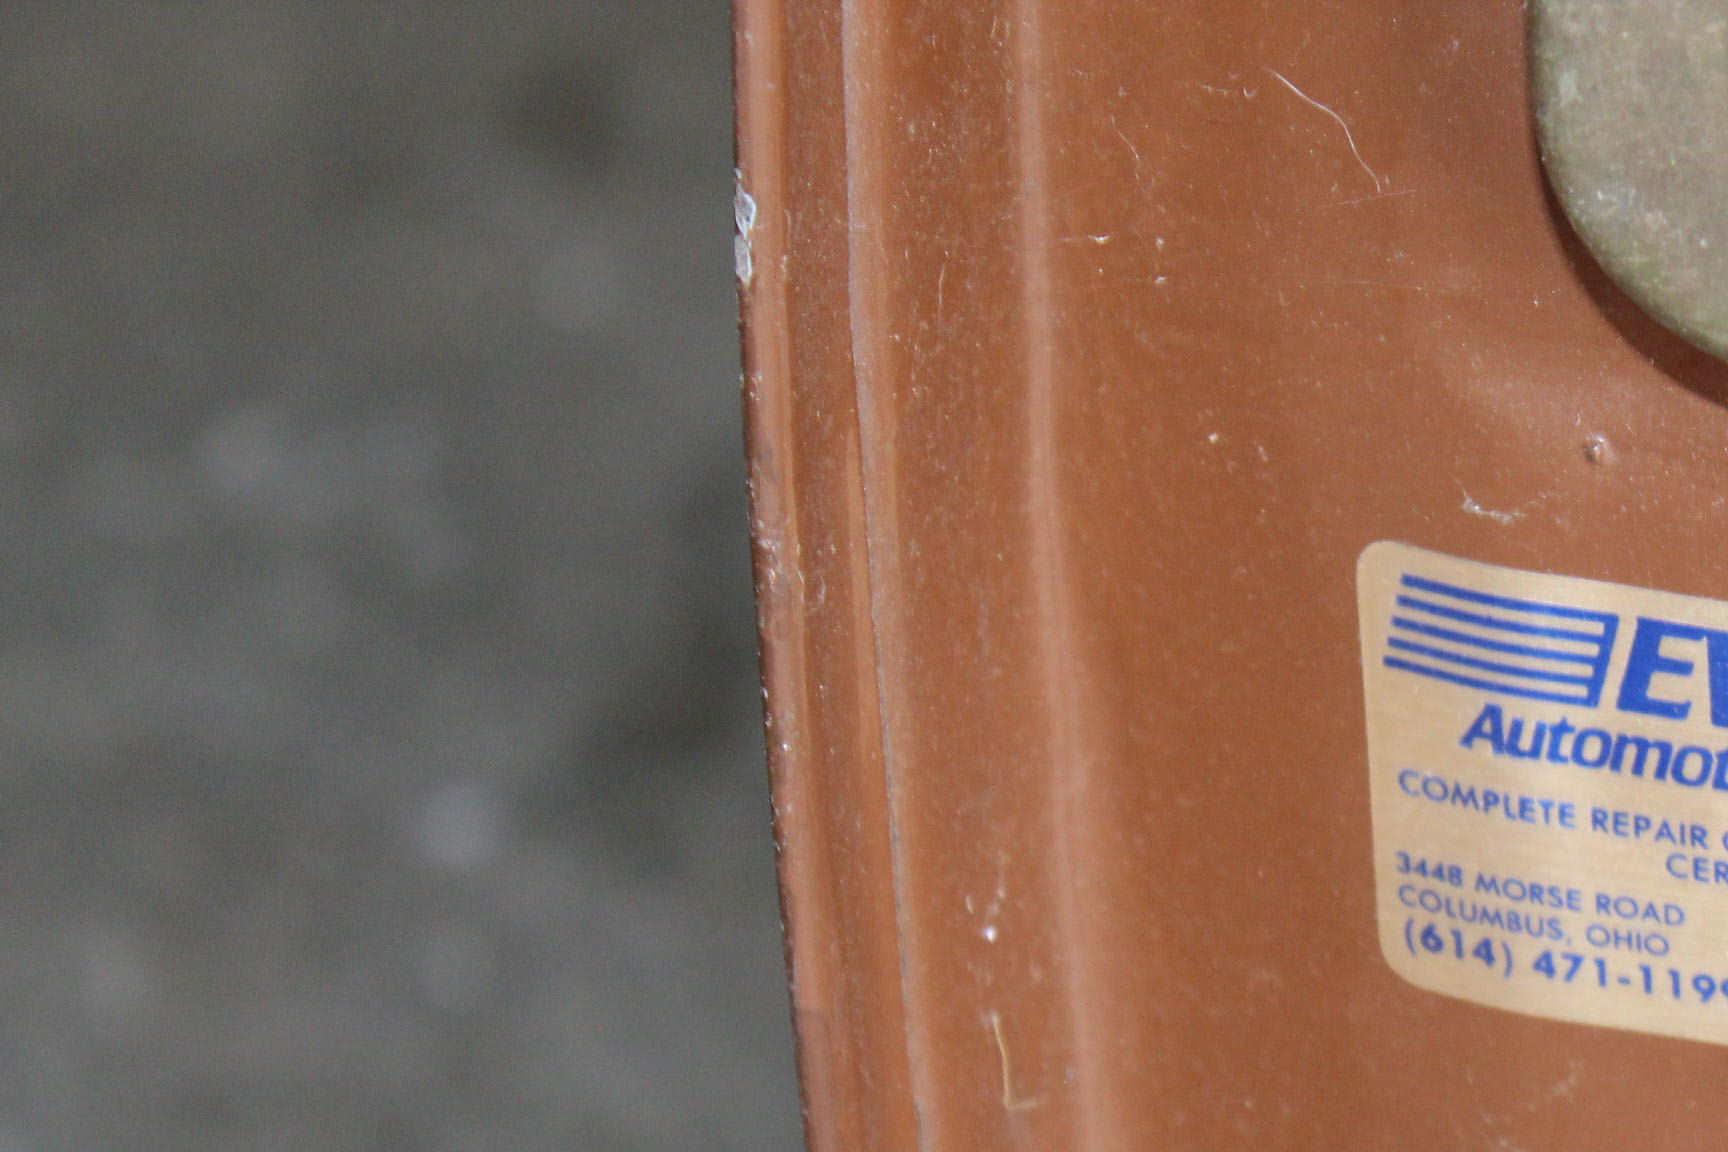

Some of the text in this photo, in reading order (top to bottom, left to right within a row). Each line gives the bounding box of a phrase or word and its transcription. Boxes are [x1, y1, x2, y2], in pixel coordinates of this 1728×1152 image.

[1398, 768, 1576, 829] COMPLETE
[1591, 809, 1707, 850] REPAIR
[1395, 850, 1685, 926] 3448 MORSE ROAD
[1398, 885, 1669, 956] COLUMBUS, OHIO
[1404, 918, 1514, 977] (614)
